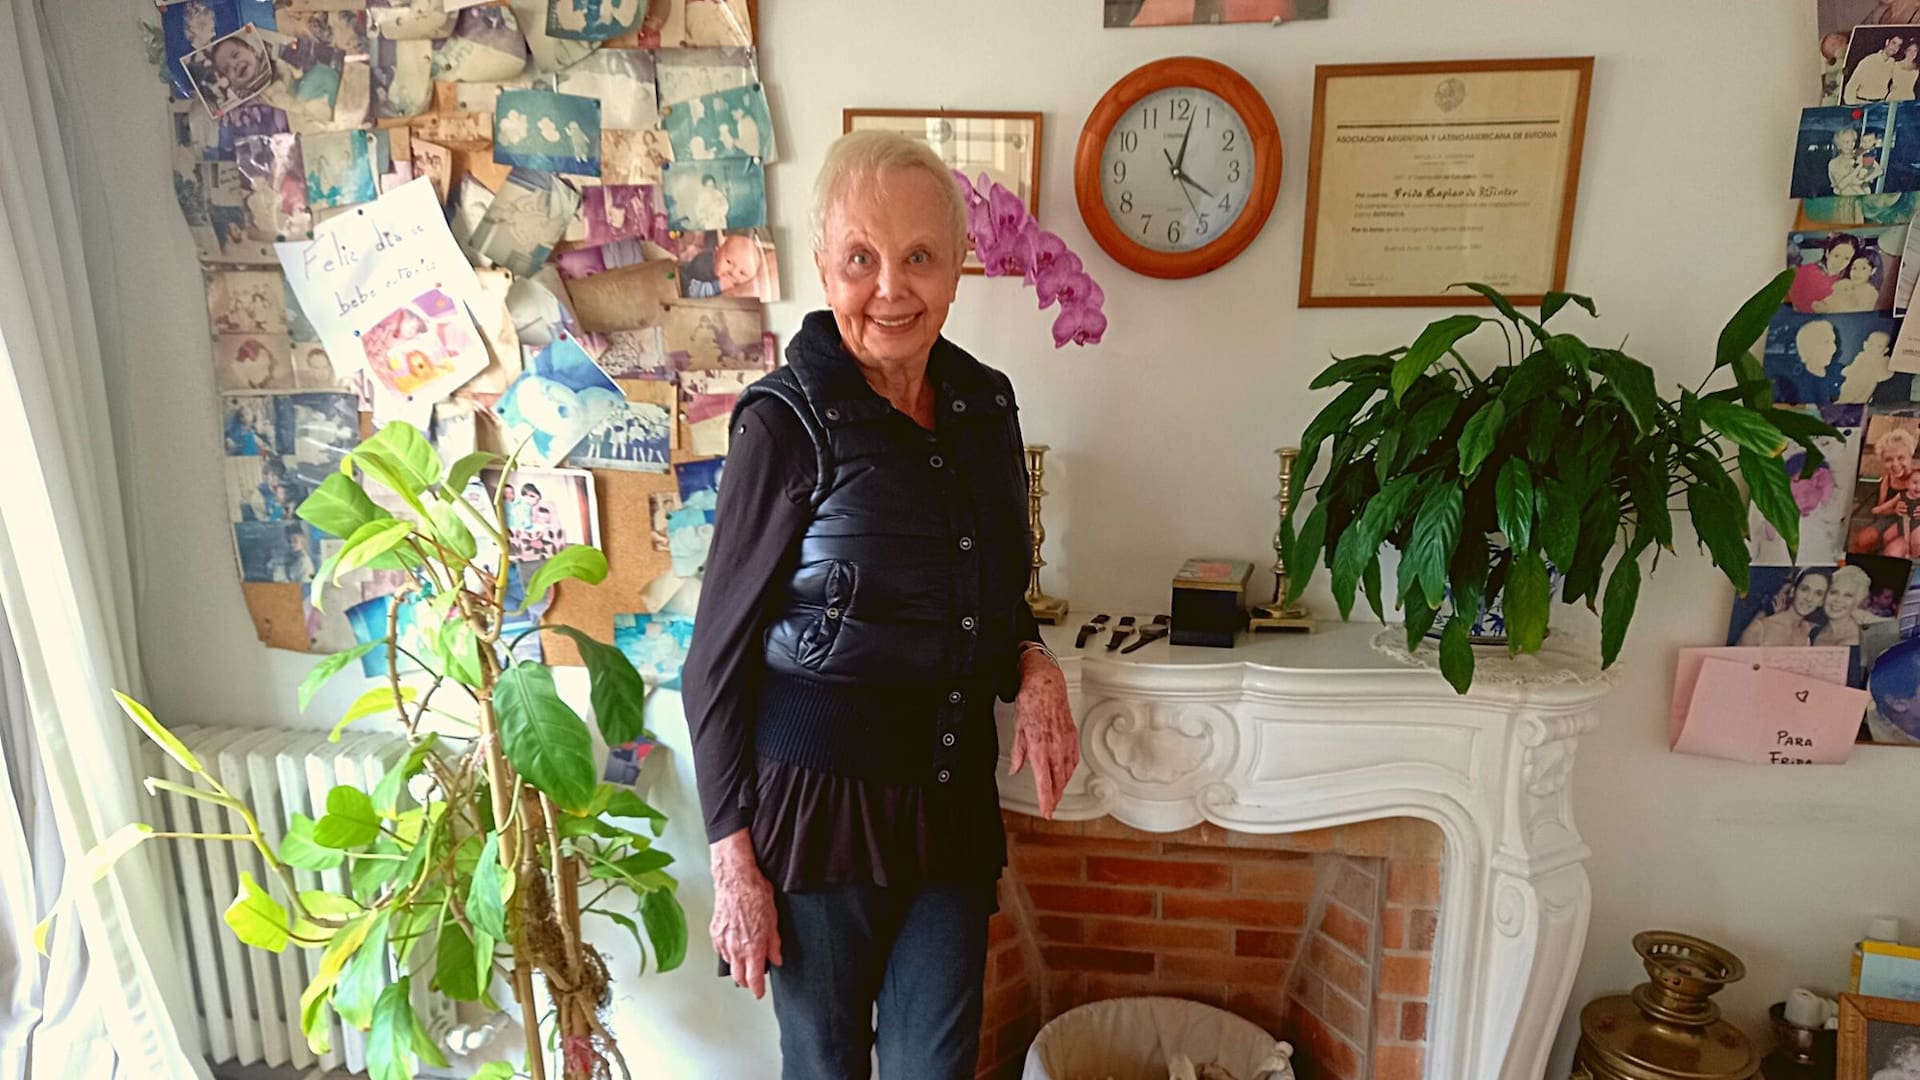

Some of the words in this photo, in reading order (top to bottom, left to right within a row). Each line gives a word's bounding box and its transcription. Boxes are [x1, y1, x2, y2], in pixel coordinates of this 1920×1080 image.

[1143, 108, 1158, 130] 11
[1170, 98, 1190, 121] 12
[1205, 107, 1211, 129] 1
[1119, 131, 1138, 153] 10
[1222, 129, 1235, 152] 2
[1335, 134, 1386, 144] ASOCIACION
[1113, 160, 1127, 184] 9
[1227, 160, 1240, 183] 3
[1119, 191, 1133, 214] 8
[1217, 192, 1231, 213] 4
[1140, 214, 1152, 235] 7
[1167, 220, 1181, 244] 6
[1195, 213, 1209, 235] 5
[1776, 730, 1813, 748] PARA
